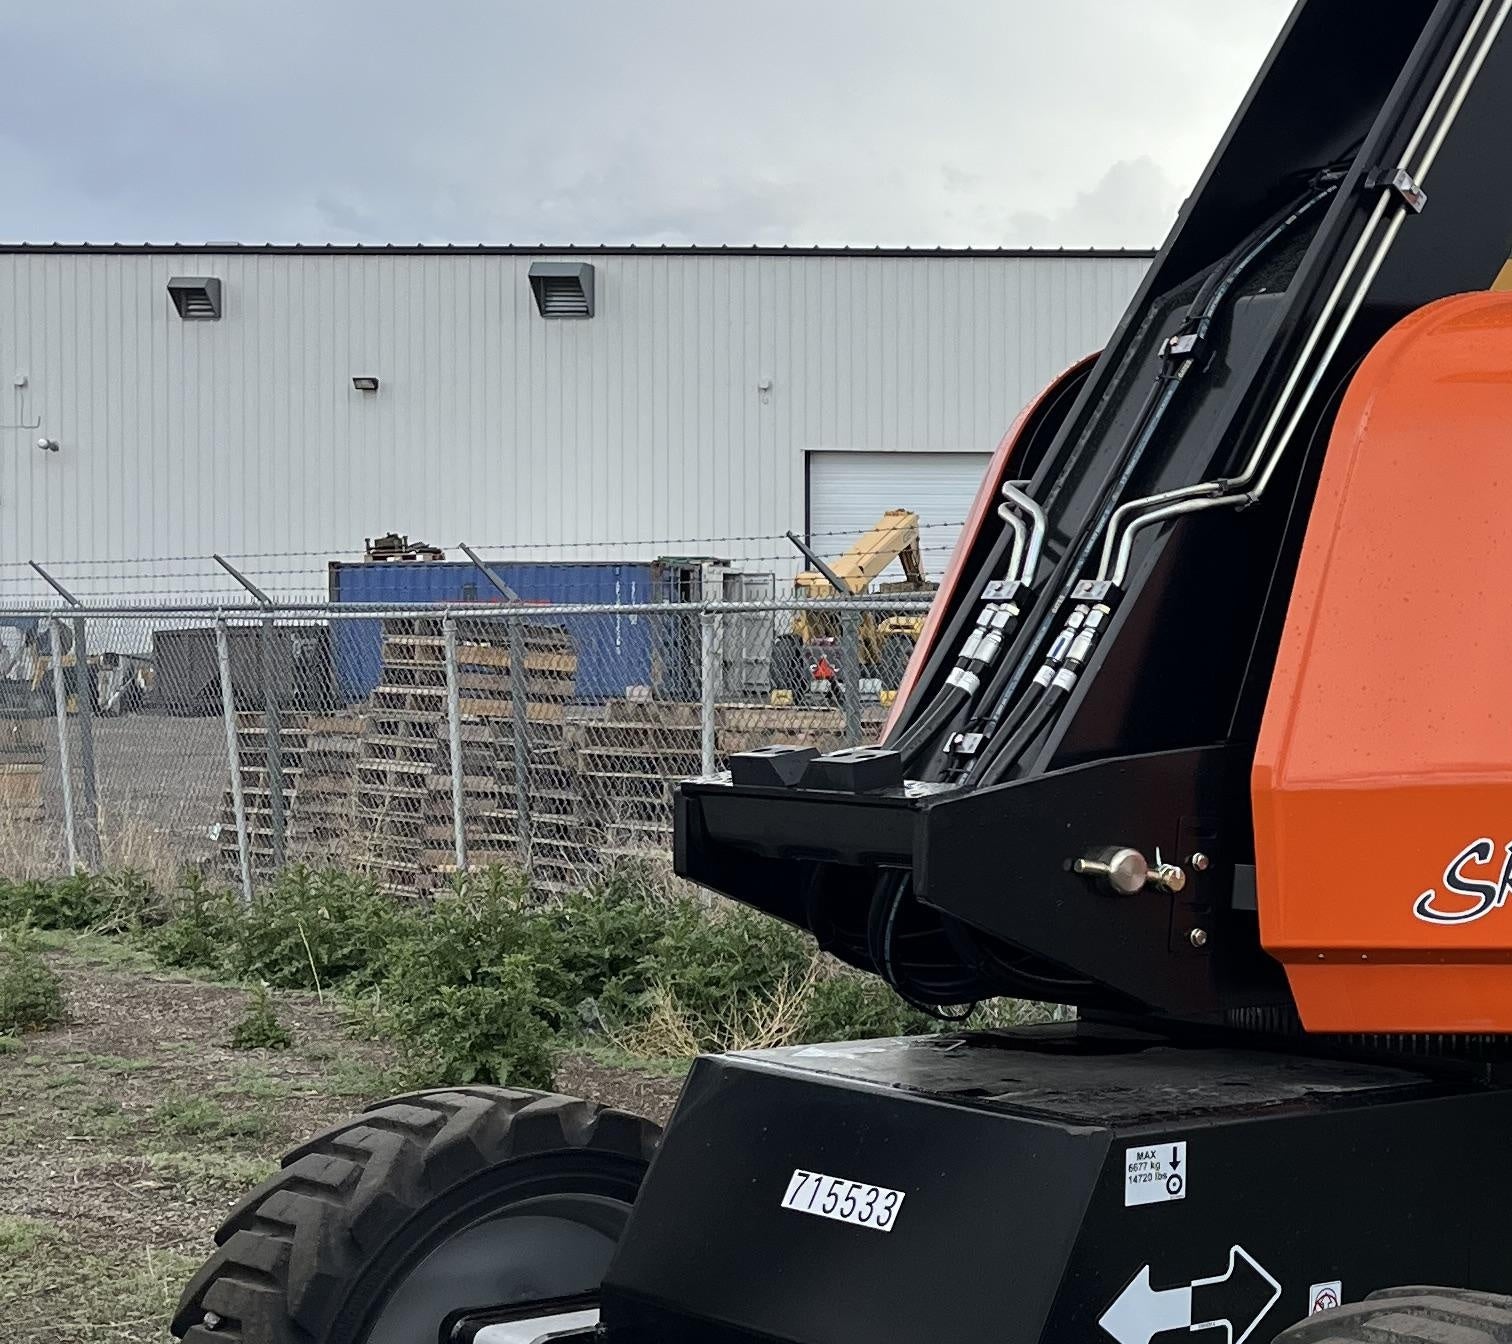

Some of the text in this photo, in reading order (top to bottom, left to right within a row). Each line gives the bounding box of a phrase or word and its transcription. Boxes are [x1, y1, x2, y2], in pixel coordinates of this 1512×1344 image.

[1137, 1150, 1157, 1160] MAX
[1150, 1161, 1161, 1172] kg
[788, 1171, 898, 1227] 715533
